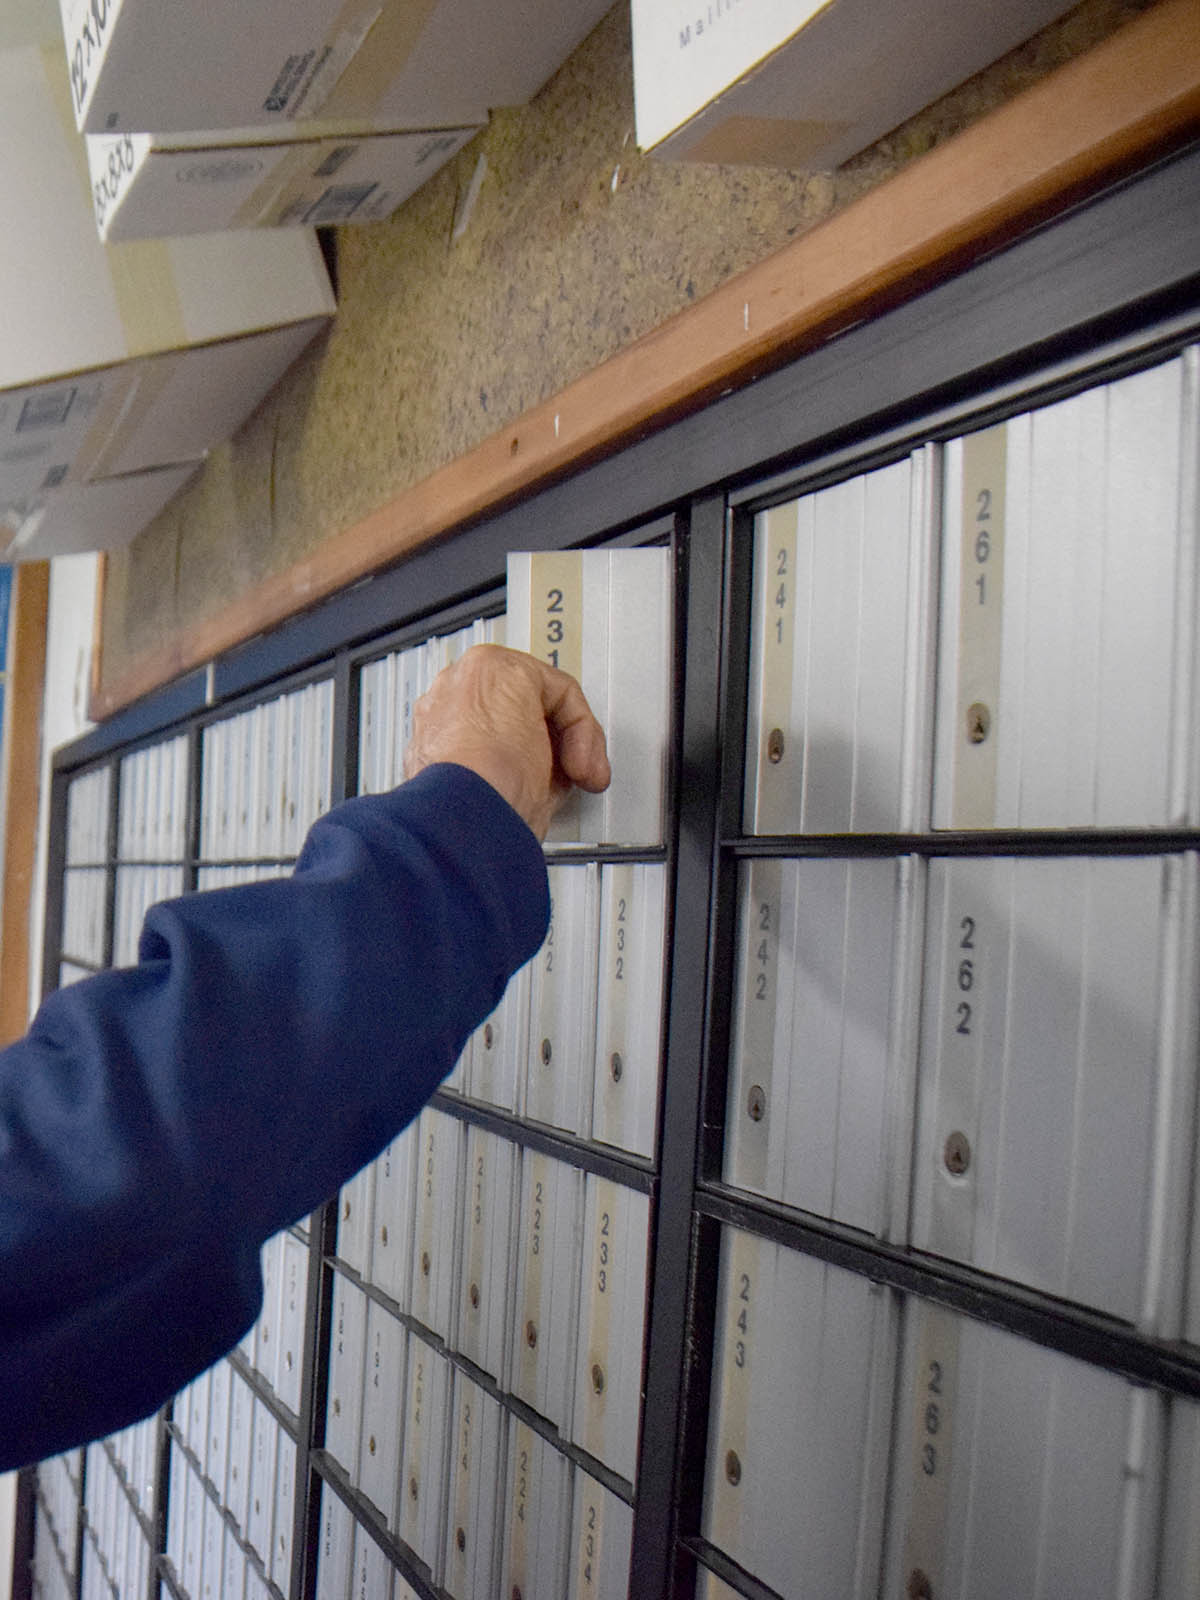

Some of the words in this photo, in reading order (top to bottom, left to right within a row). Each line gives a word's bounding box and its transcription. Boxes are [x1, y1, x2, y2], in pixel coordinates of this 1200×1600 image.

[974, 489, 992, 606] 261
[546, 588, 564, 669] 231
[775, 548, 788, 645] 241
[615, 897, 627, 981] 232
[755, 903, 771, 1001] 242
[956, 915, 977, 1035] 262
[531, 1181, 543, 1256] 223
[598, 1211, 611, 1294] 233
[734, 1272, 751, 1369] 243
[921, 1359, 944, 1477] 263
[517, 1450, 528, 1523] 224
[583, 1504, 597, 1585] 234
